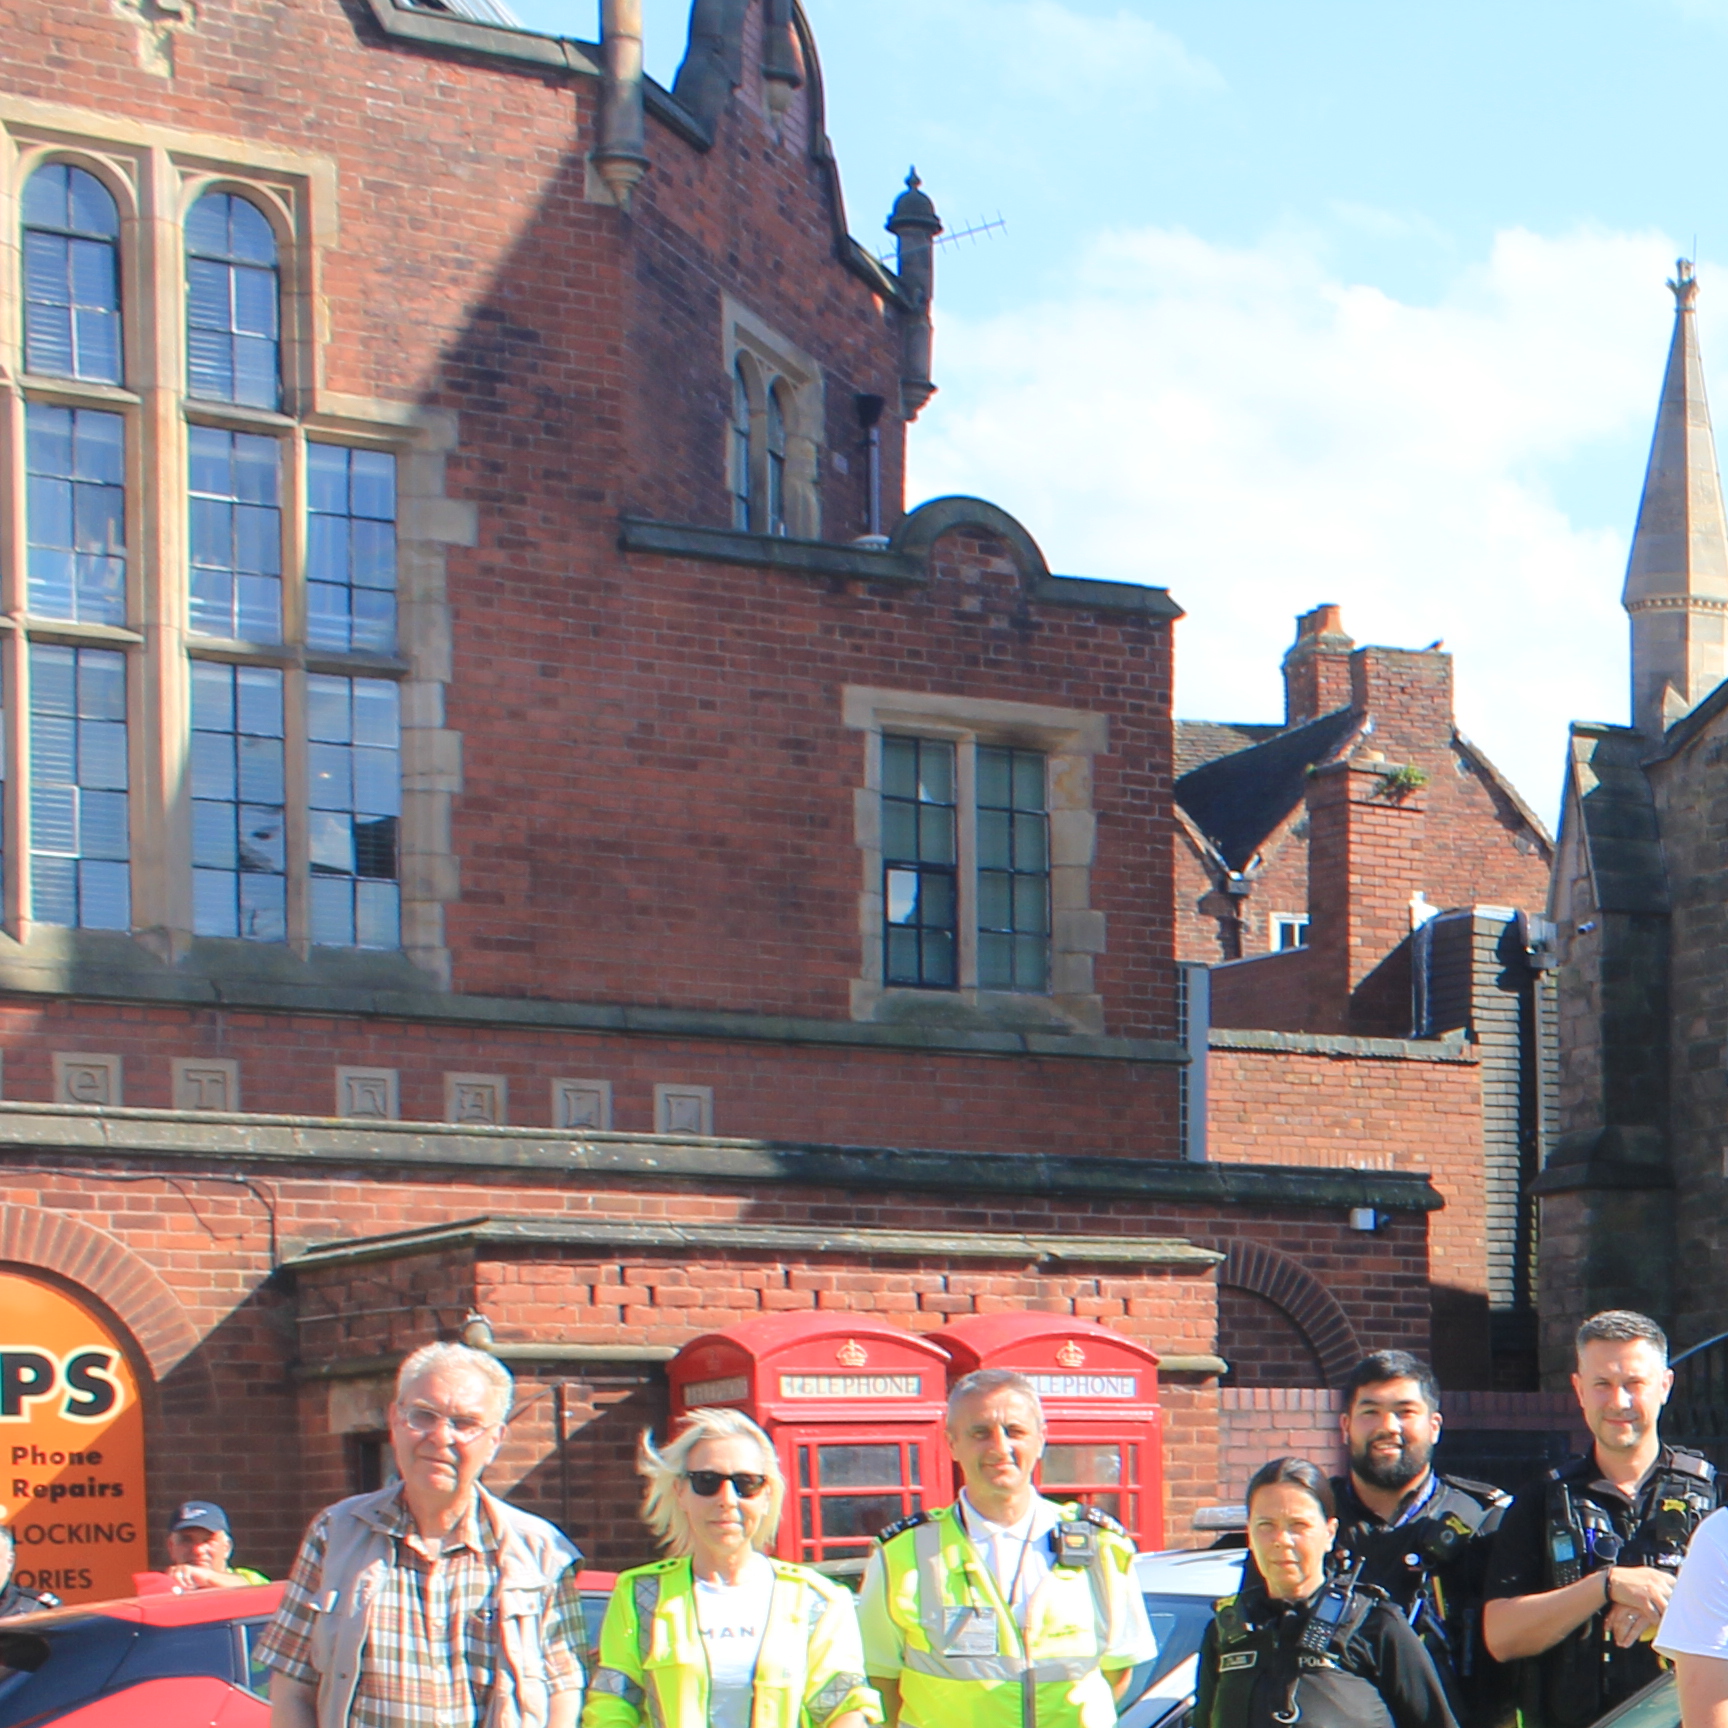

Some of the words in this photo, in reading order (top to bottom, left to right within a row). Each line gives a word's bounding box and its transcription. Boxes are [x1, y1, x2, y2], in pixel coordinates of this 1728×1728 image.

[785, 1375, 919, 1396] TELEPHONE
[11, 1446, 103, 1465] Phone
[12, 1477, 124, 1502] Repairs
[11, 1523, 136, 1545] LOCKING
[14, 1569, 93, 1589] ORIES
